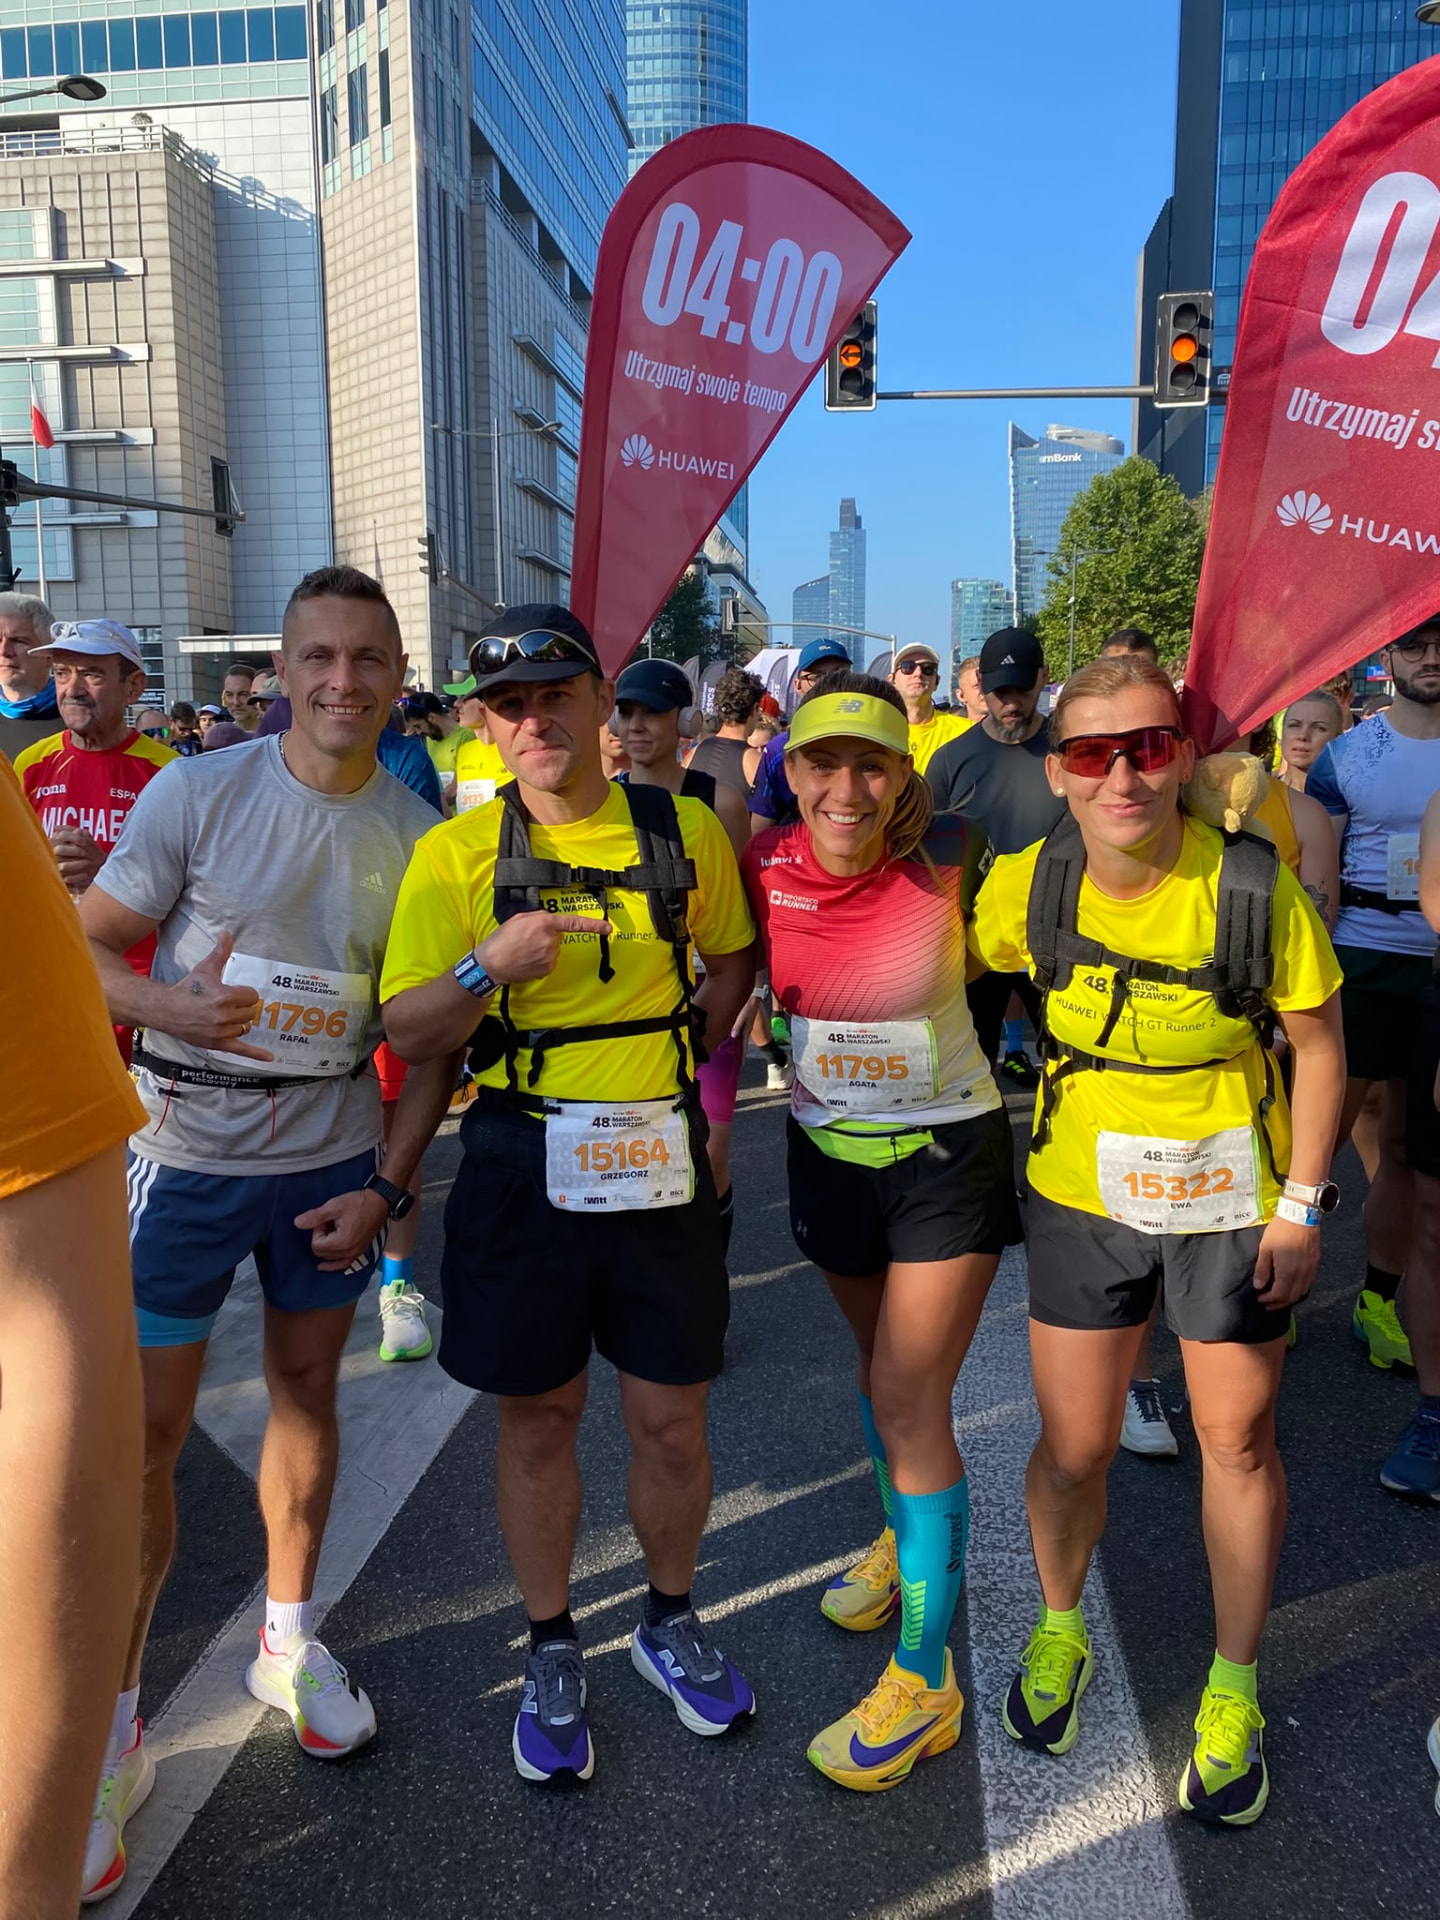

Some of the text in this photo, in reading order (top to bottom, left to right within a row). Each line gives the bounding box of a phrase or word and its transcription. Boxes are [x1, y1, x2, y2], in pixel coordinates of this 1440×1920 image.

[642, 202, 842, 363] 04:00
[624, 350, 787, 414] Utrzymaj swoje tempo
[1286, 387, 1420, 450] Utrzymaj
[658, 449, 735, 480] HUAWEI
[1041, 452, 1082, 463] mBank
[110, 787, 140, 801] ESPA
[42, 806, 131, 843] MICHAE
[561, 896, 600, 906] MARATO
[562, 902, 625, 913] WARSZASKI
[781, 899, 818, 911] RUNNER
[617, 930, 652, 941] Runner
[271, 975, 293, 990] 48.
[294, 978, 329, 989] MARATON
[1083, 975, 1109, 994] 48.
[293, 984, 340, 997] WARSZAWSKI
[251, 998, 348, 1038] 11796
[1055, 995, 1097, 1020] HUAWEI
[1147, 1019, 1163, 1030] GT
[1166, 1021, 1206, 1033] Runner
[1209, 1017, 1216, 1028] 2
[828, 1033, 846, 1043] 48.
[815, 1053, 909, 1081] 11795
[181, 1069, 260, 1084] performance
[191, 1077, 237, 1088] recovery
[849, 1080, 877, 1088] AGATA
[592, 1115, 643, 1129] 48. MARATON
[612, 1120, 651, 1128] WARSZAWSKI
[573, 1138, 670, 1172] 15164
[1143, 1150, 1200, 1162] 48. MARATON
[1165, 1152, 1212, 1164] WARSZAWSKI
[600, 1170, 649, 1181] GRZEGORZ
[1122, 1167, 1235, 1201] 15322
[1170, 1201, 1192, 1209] EWA
